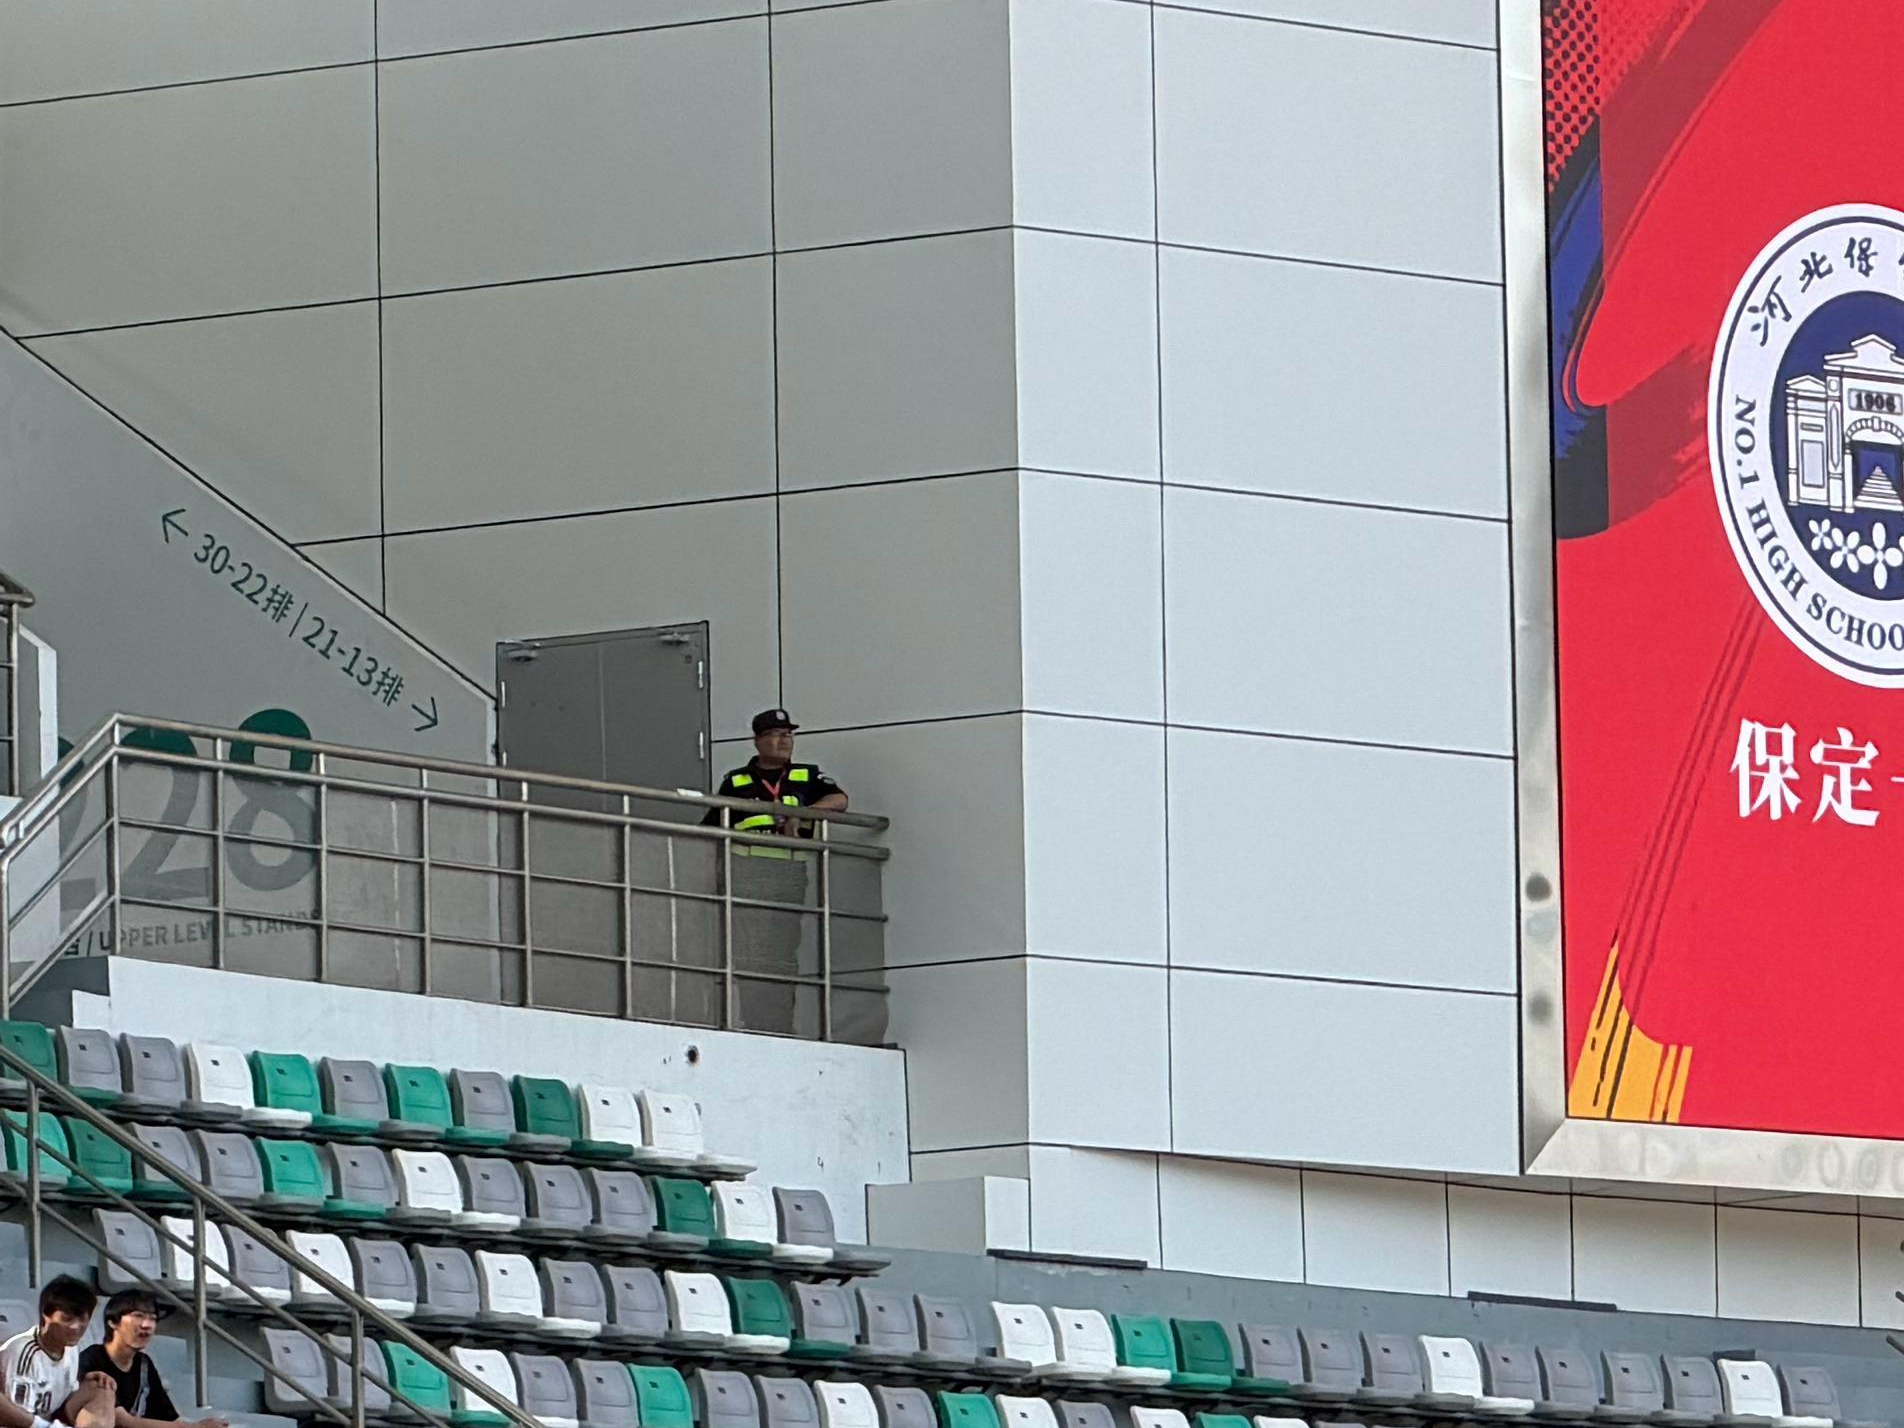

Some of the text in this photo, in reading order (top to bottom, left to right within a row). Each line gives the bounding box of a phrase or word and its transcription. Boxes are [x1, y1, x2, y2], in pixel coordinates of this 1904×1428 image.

[1746, 498, 1809, 601] HIGH
[194, 533, 404, 707] 30-22排 21-13排
